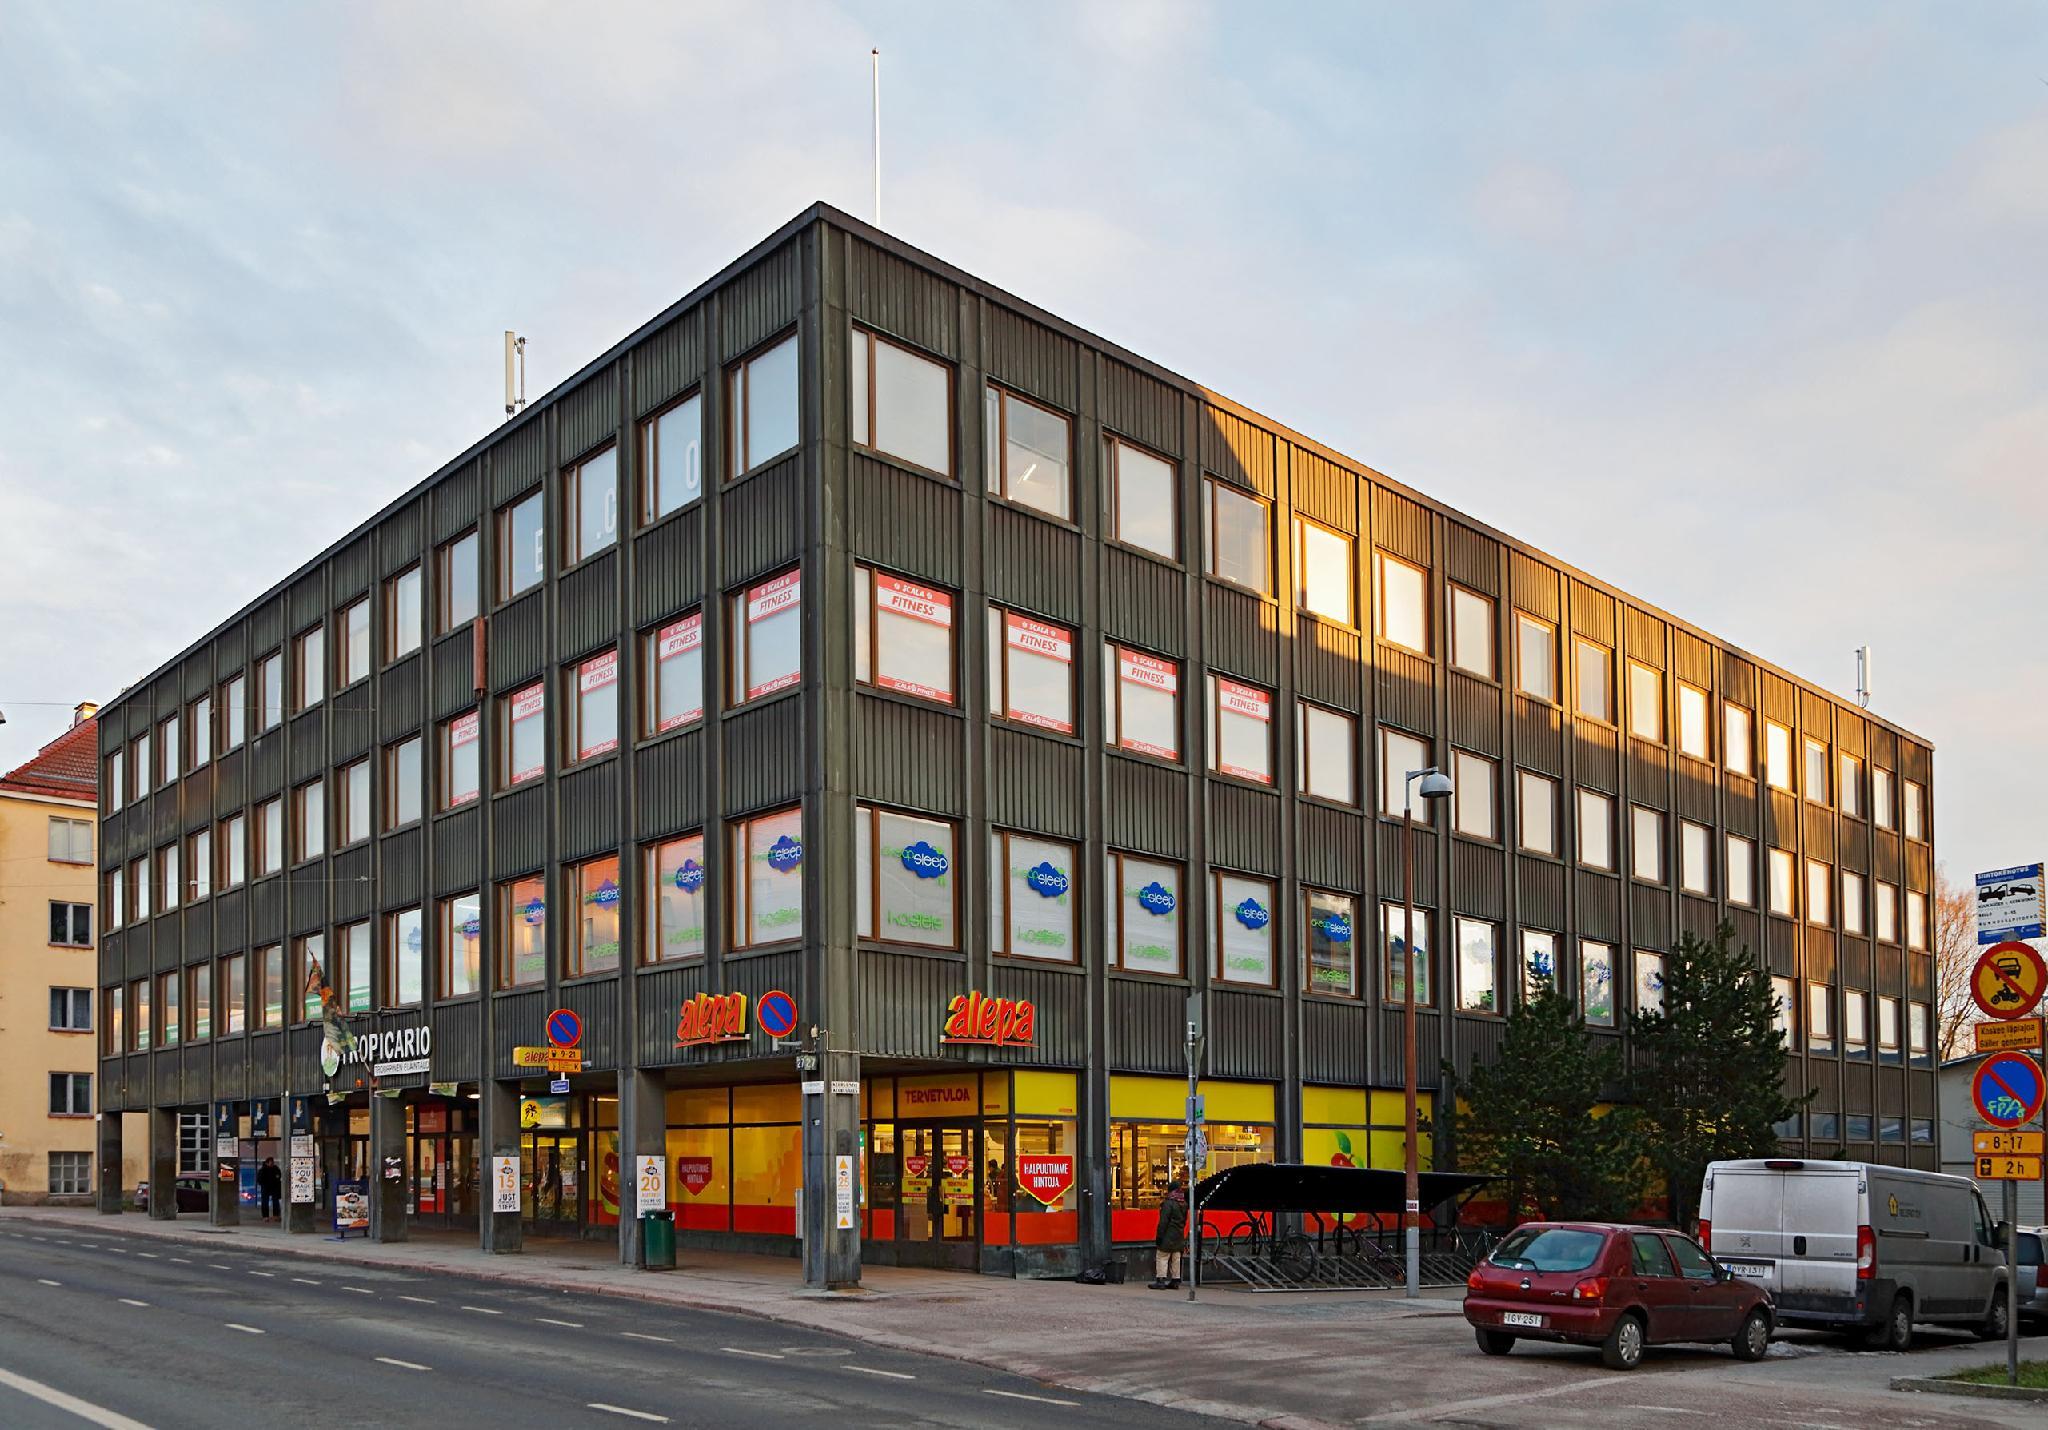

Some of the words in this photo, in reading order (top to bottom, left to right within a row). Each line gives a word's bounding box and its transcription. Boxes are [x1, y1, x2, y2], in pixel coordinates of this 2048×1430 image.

[902, 584, 925, 597] SCALA
[760, 589, 792, 613] FITNESS
[891, 595, 935, 616] FITNESS
[1029, 623, 1049, 635] SCALA
[669, 630, 697, 652] FITNESS
[1020, 633, 1057, 652] FITNESS
[589, 666, 614, 684] FITNESS
[1131, 666, 1165, 685] FITNESS
[1229, 696, 1260, 713] FITNESS
[775, 845, 802, 862] sleep
[913, 853, 948, 873] sleep
[1038, 873, 1068, 891] sleep
[1148, 892, 1175, 909] sleep
[1244, 908, 1269, 924] sleep
[677, 992, 747, 1044] alepa
[944, 990, 1035, 1047] alepa
[905, 1087, 970, 1104] TERVETULOA
[1024, 1163, 1068, 1175] HALPUUTIMME
[2006, 1161, 2014, 1174] 2
[2018, 1161, 2024, 1174] h
[499, 1175, 515, 1189] 15
[641, 1176, 661, 1191] 20
